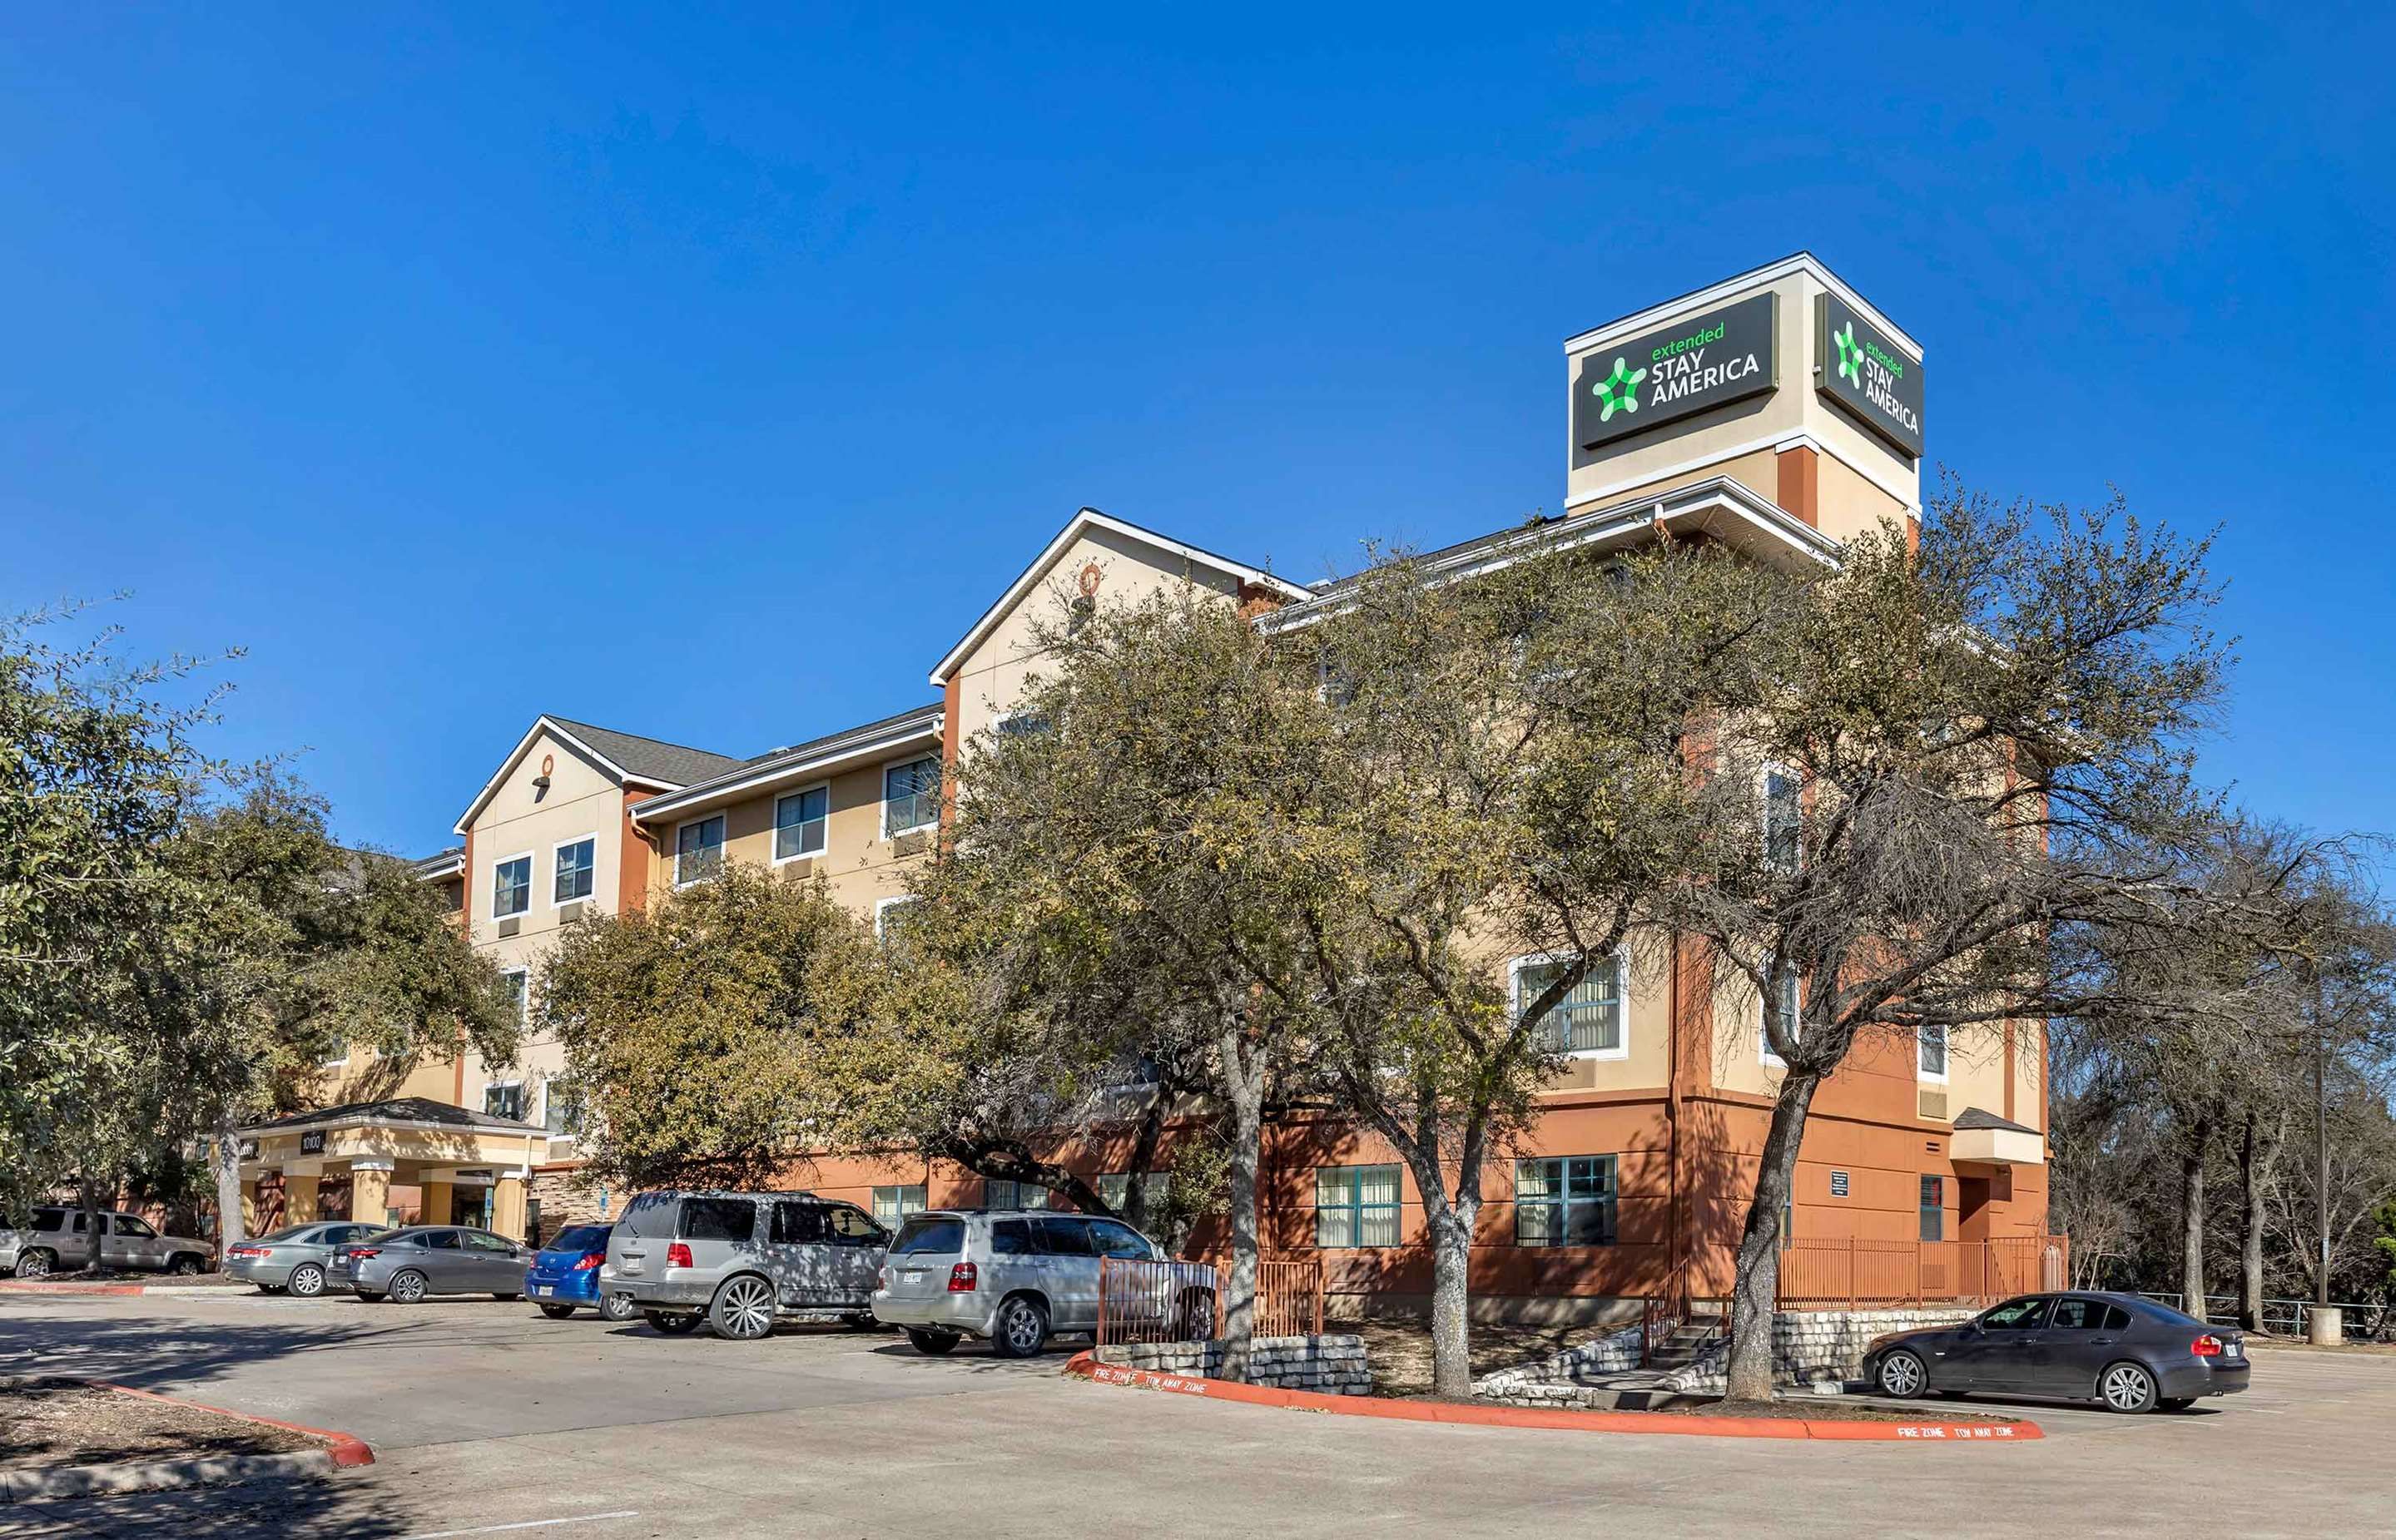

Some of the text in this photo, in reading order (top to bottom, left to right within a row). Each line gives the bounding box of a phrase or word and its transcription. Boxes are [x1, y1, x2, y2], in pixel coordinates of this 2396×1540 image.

[1652, 321, 1724, 360] extended
[1652, 348, 1705, 384] STAY
[1866, 342, 1902, 379] extended
[1867, 357, 1893, 393] STAY
[1651, 354, 1760, 407] AMERICA
[1866, 379, 1919, 435] AMERICA
[1094, 1368, 1110, 1379] FIRE
[1146, 1375, 1161, 1385] TOW
[1163, 1378, 1183, 1389] AWAY
[1184, 1382, 1208, 1393] ZONE
[1897, 1427, 2015, 1438] FIRE ZONE TOW AWAY ZONE
